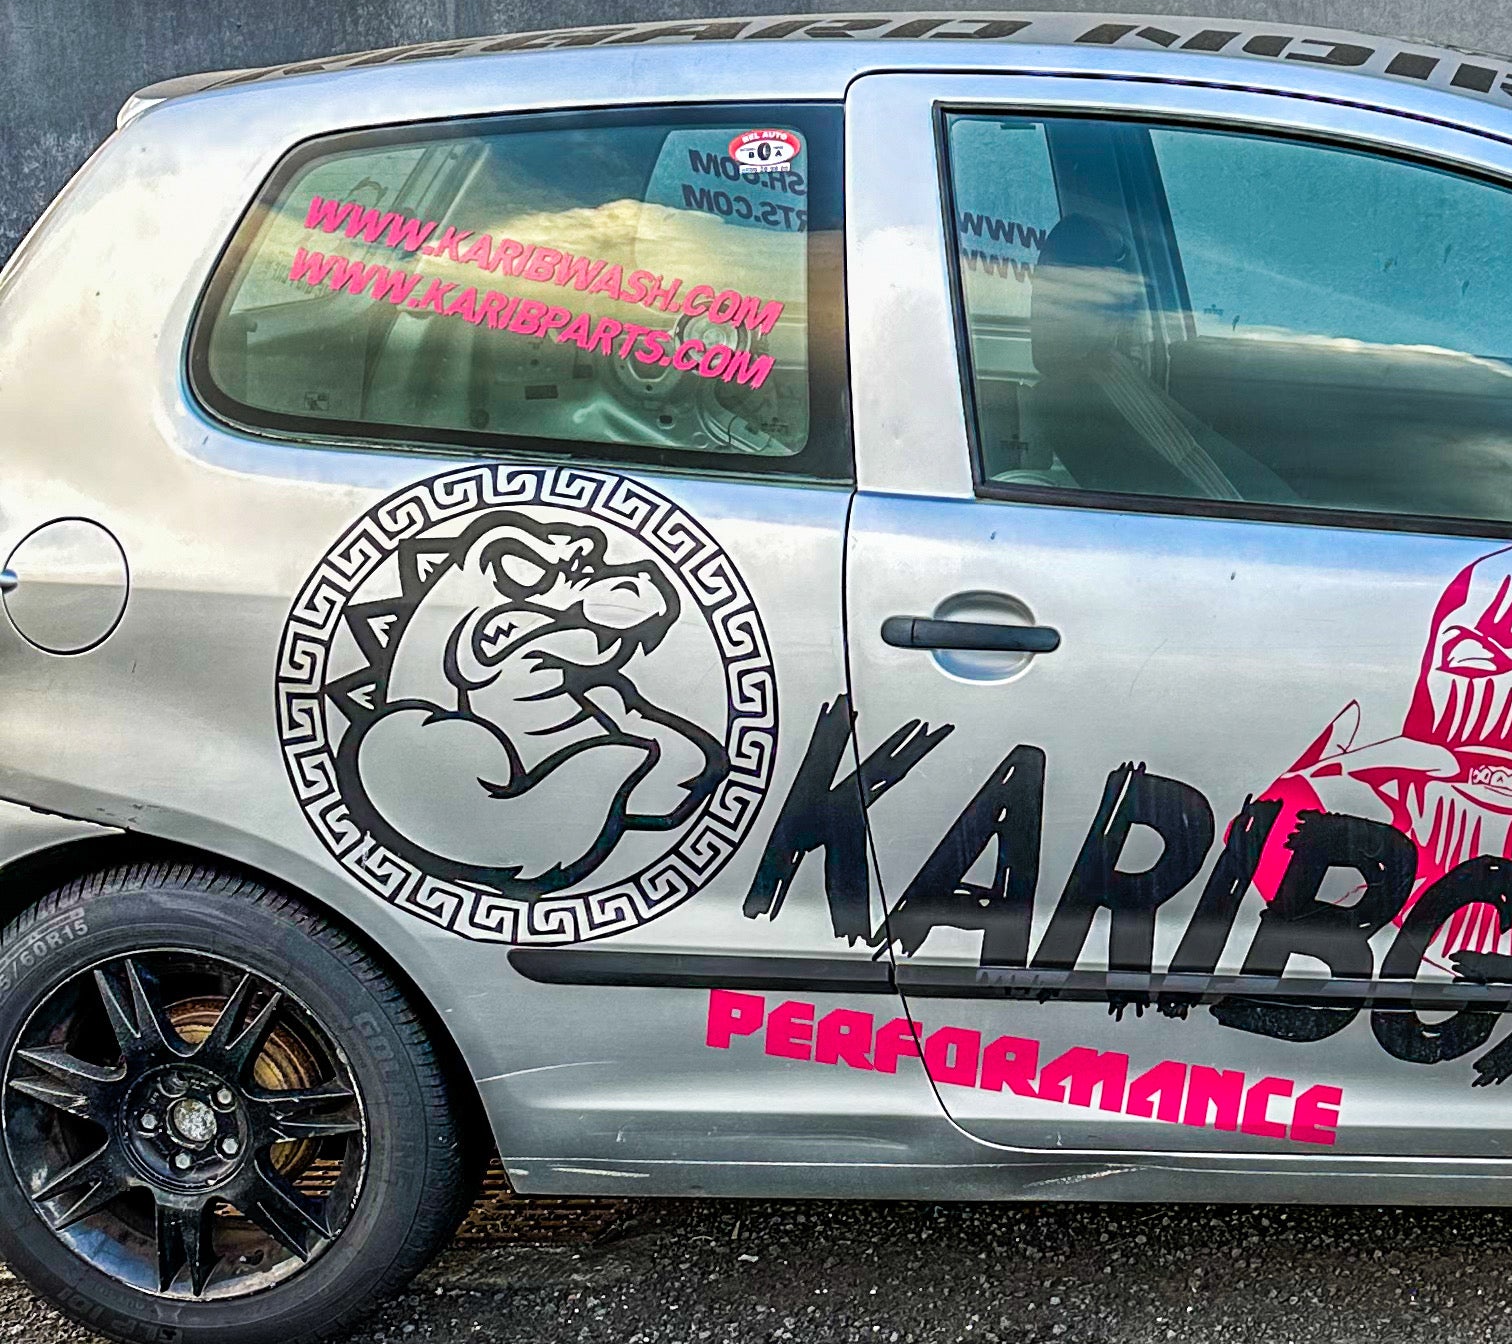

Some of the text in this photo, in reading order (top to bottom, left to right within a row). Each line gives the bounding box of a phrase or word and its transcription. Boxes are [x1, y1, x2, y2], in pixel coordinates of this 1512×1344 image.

[762, 131, 788, 141] AUTO
[287, 247, 776, 390] WWW.KARIBPARTS.COM
[303, 195, 784, 335] WWW.KARIBWASH.COM
[704, 987, 1344, 1147] PERFORMANCE
